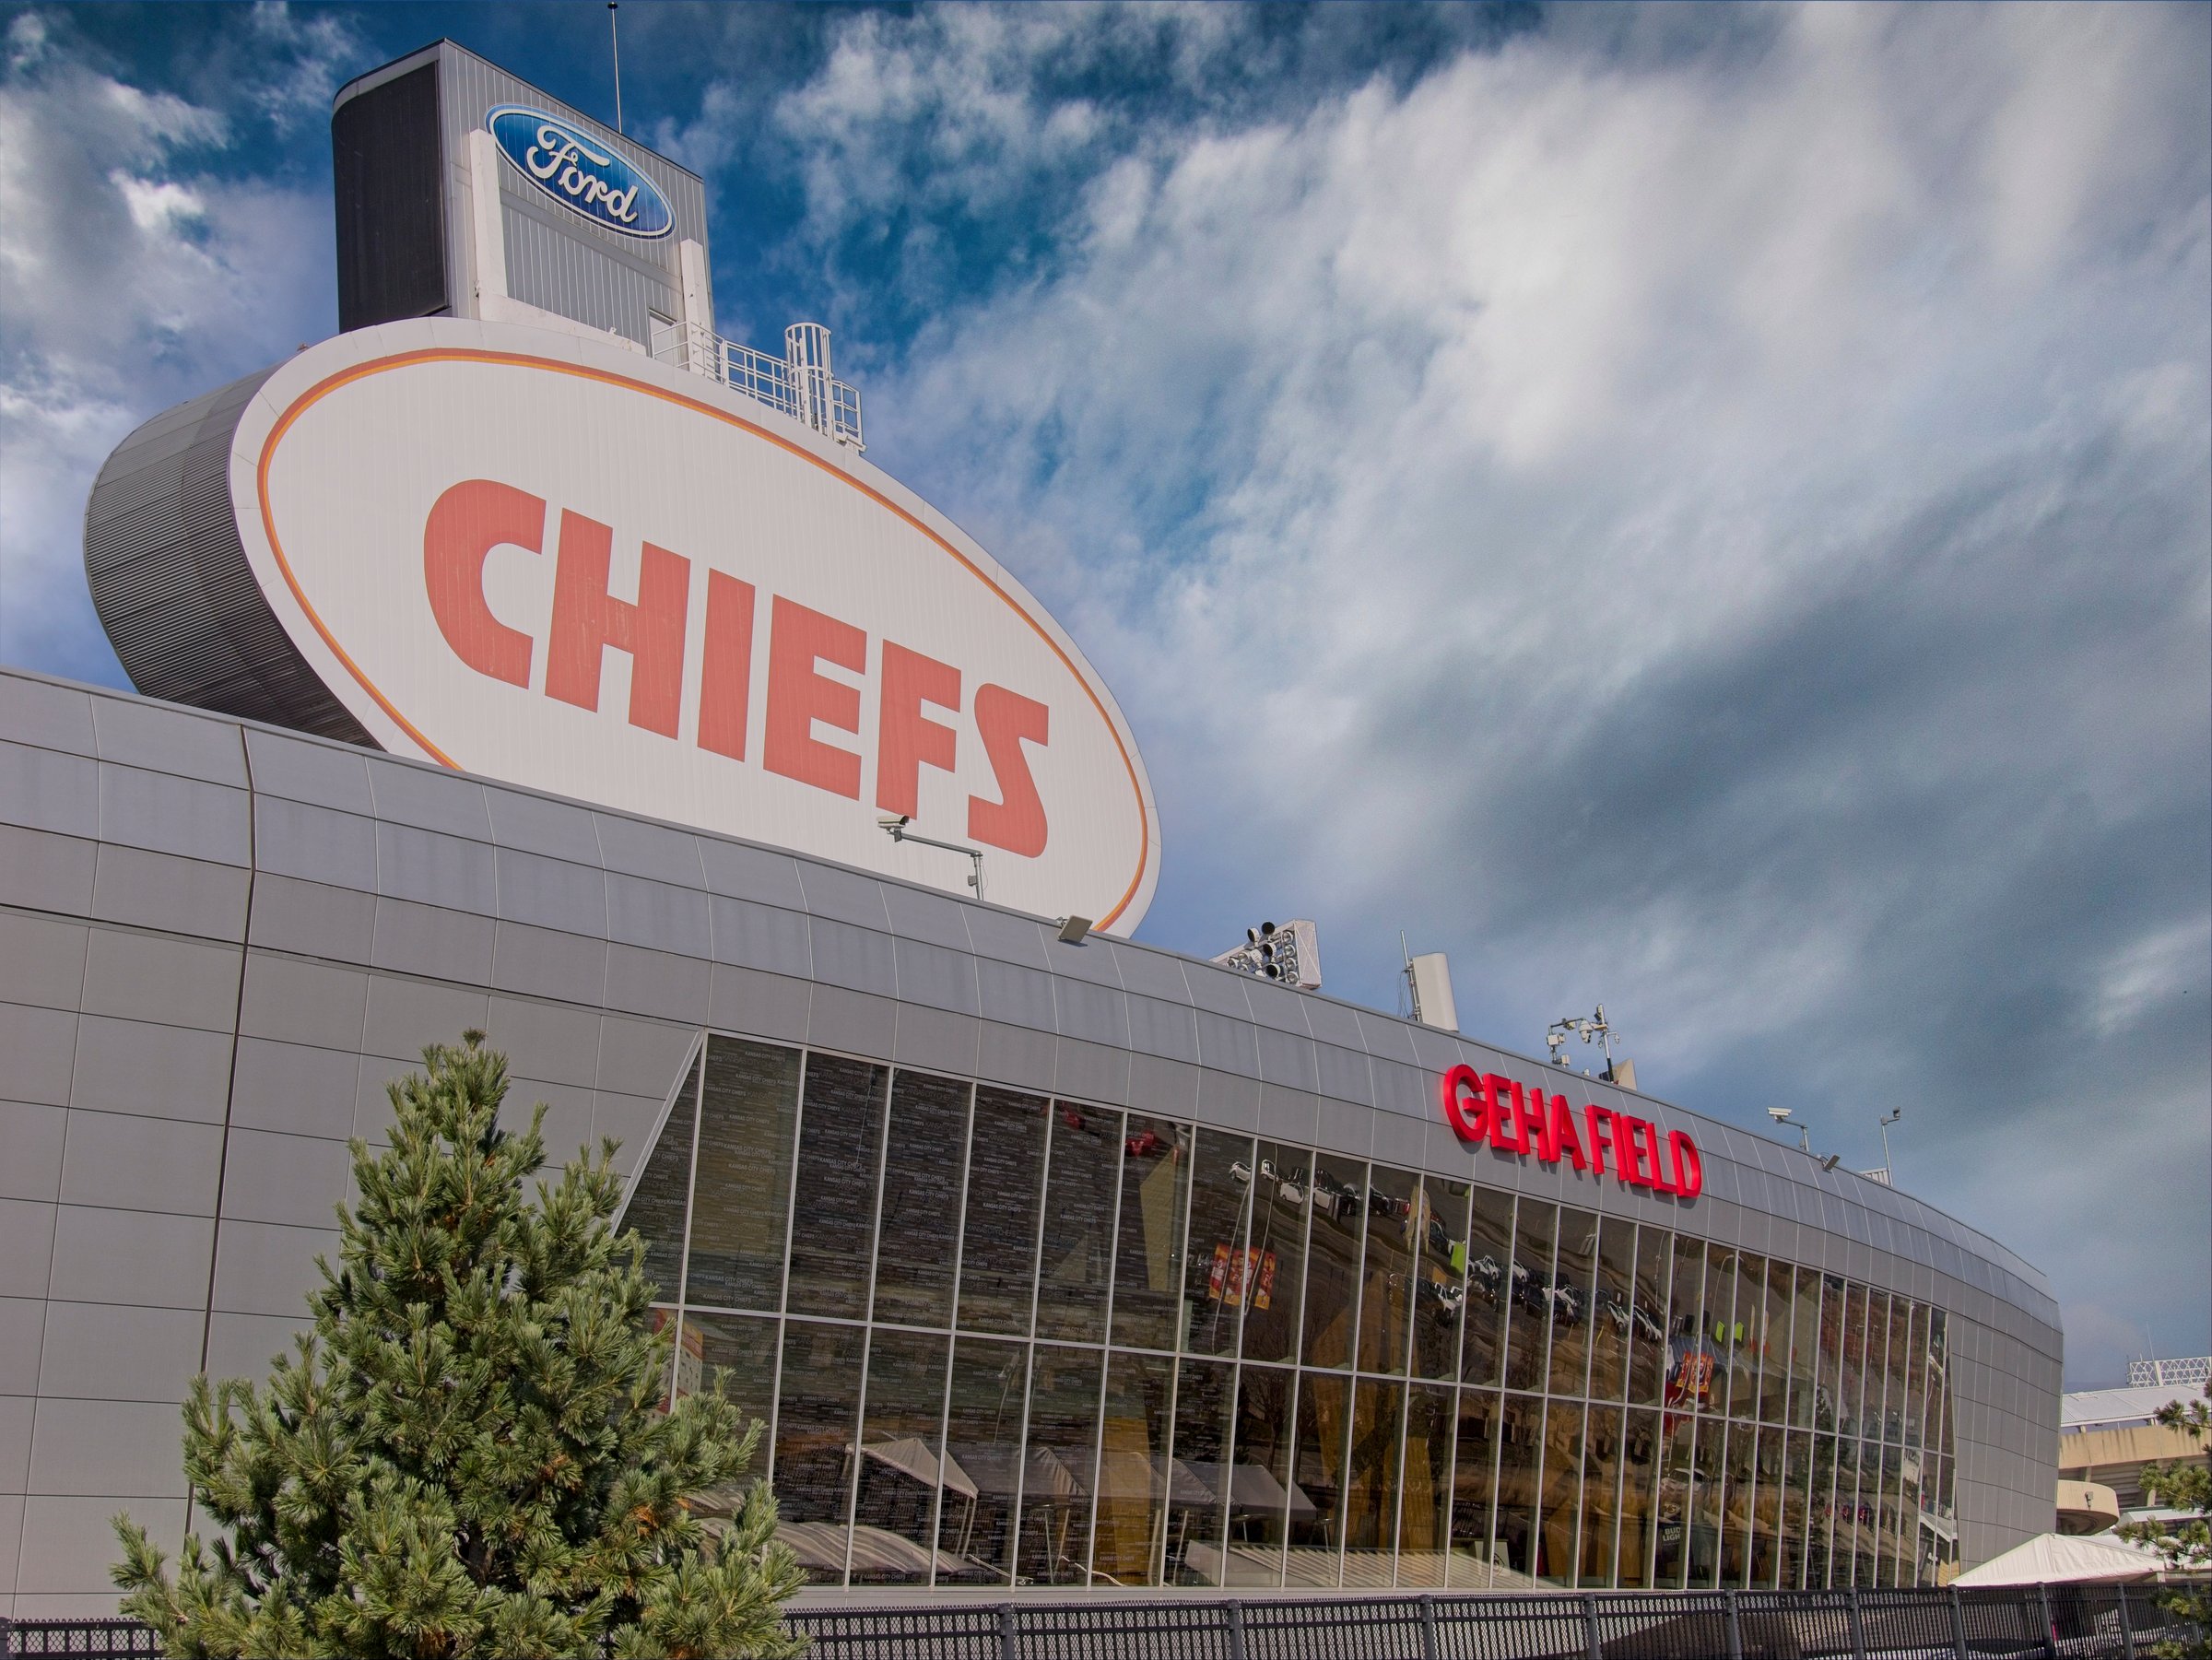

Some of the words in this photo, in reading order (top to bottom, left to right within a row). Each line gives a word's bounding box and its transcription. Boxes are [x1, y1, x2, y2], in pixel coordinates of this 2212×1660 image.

[526, 125, 638, 223] Ford
[424, 479, 1049, 858] CHIEFS
[1443, 1064, 1587, 1170] GEHA
[1584, 1104, 1702, 1197] FIELD
[1663, 1533, 1680, 1541] LIGH
[1665, 1526, 1681, 1535] BUD
